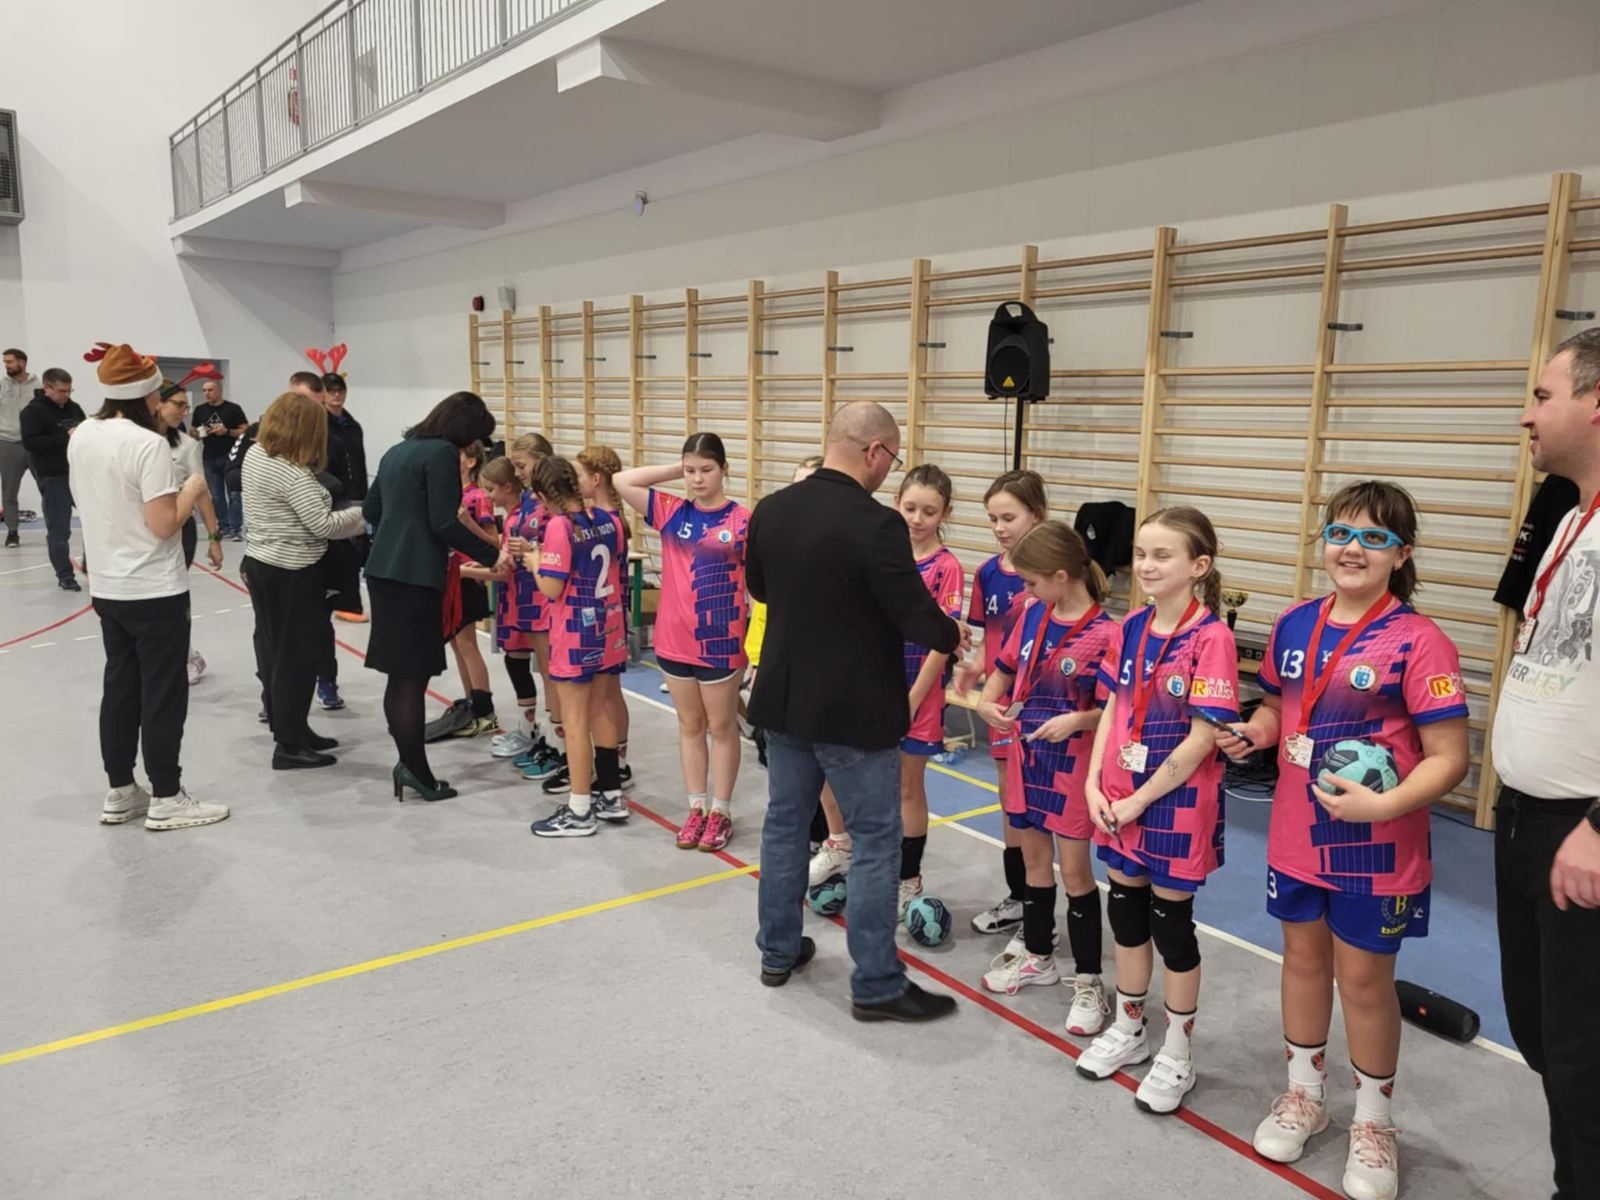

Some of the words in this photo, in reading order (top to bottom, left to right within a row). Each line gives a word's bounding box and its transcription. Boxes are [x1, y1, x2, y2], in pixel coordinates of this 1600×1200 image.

[591, 543, 615, 599] 2
[1020, 639, 1034, 661] 4
[1280, 649, 1305, 679] 13
[1119, 658, 1133, 686] 5
